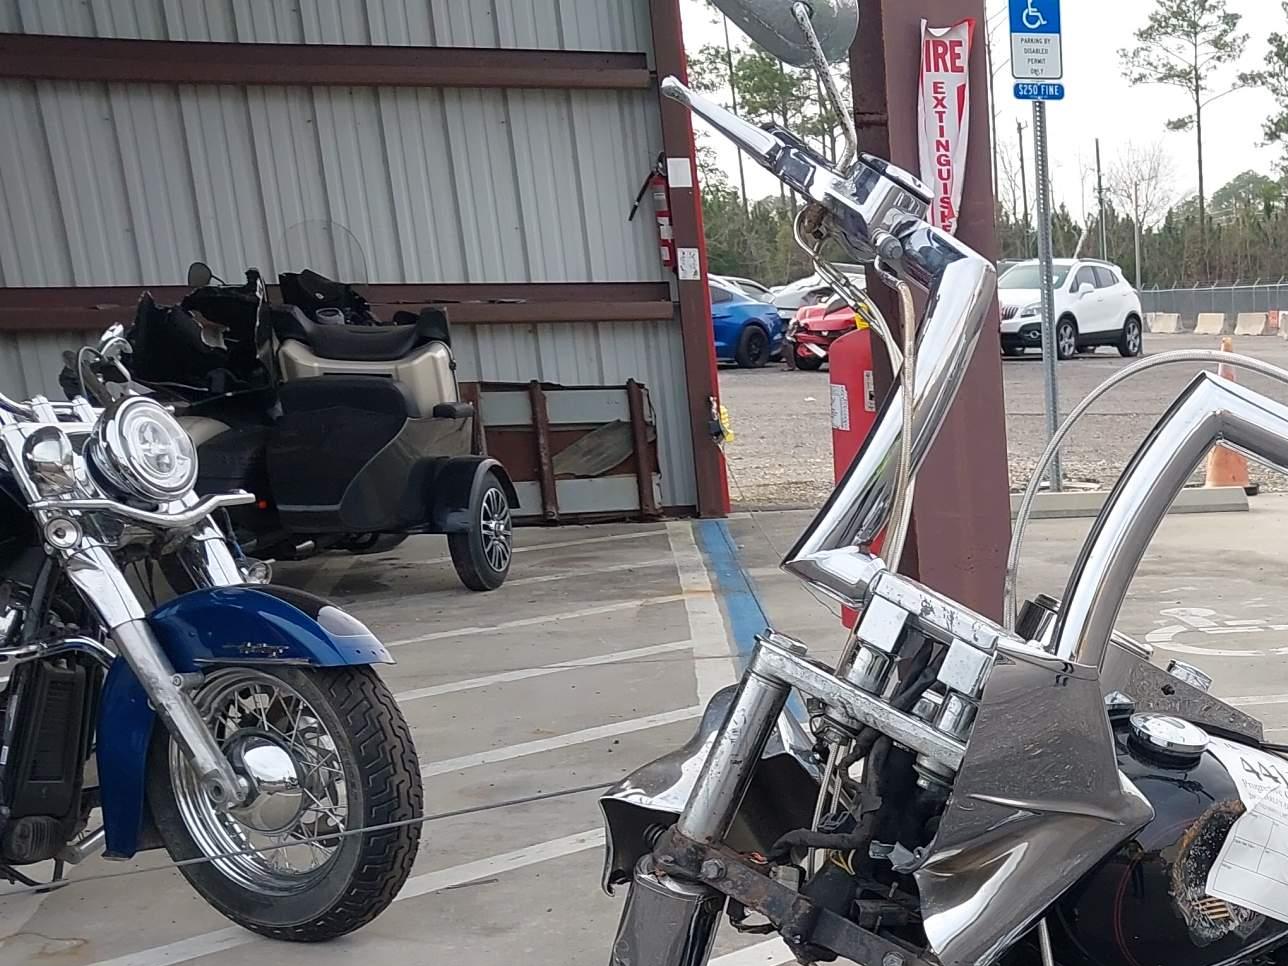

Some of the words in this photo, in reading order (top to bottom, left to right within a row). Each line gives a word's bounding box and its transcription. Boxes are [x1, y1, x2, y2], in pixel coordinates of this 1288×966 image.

[925, 40, 965, 73] IRE
[1018, 85, 1038, 95] $250
[1041, 85, 1060, 95] FINE
[932, 81, 955, 233] EXTINGUISHE
